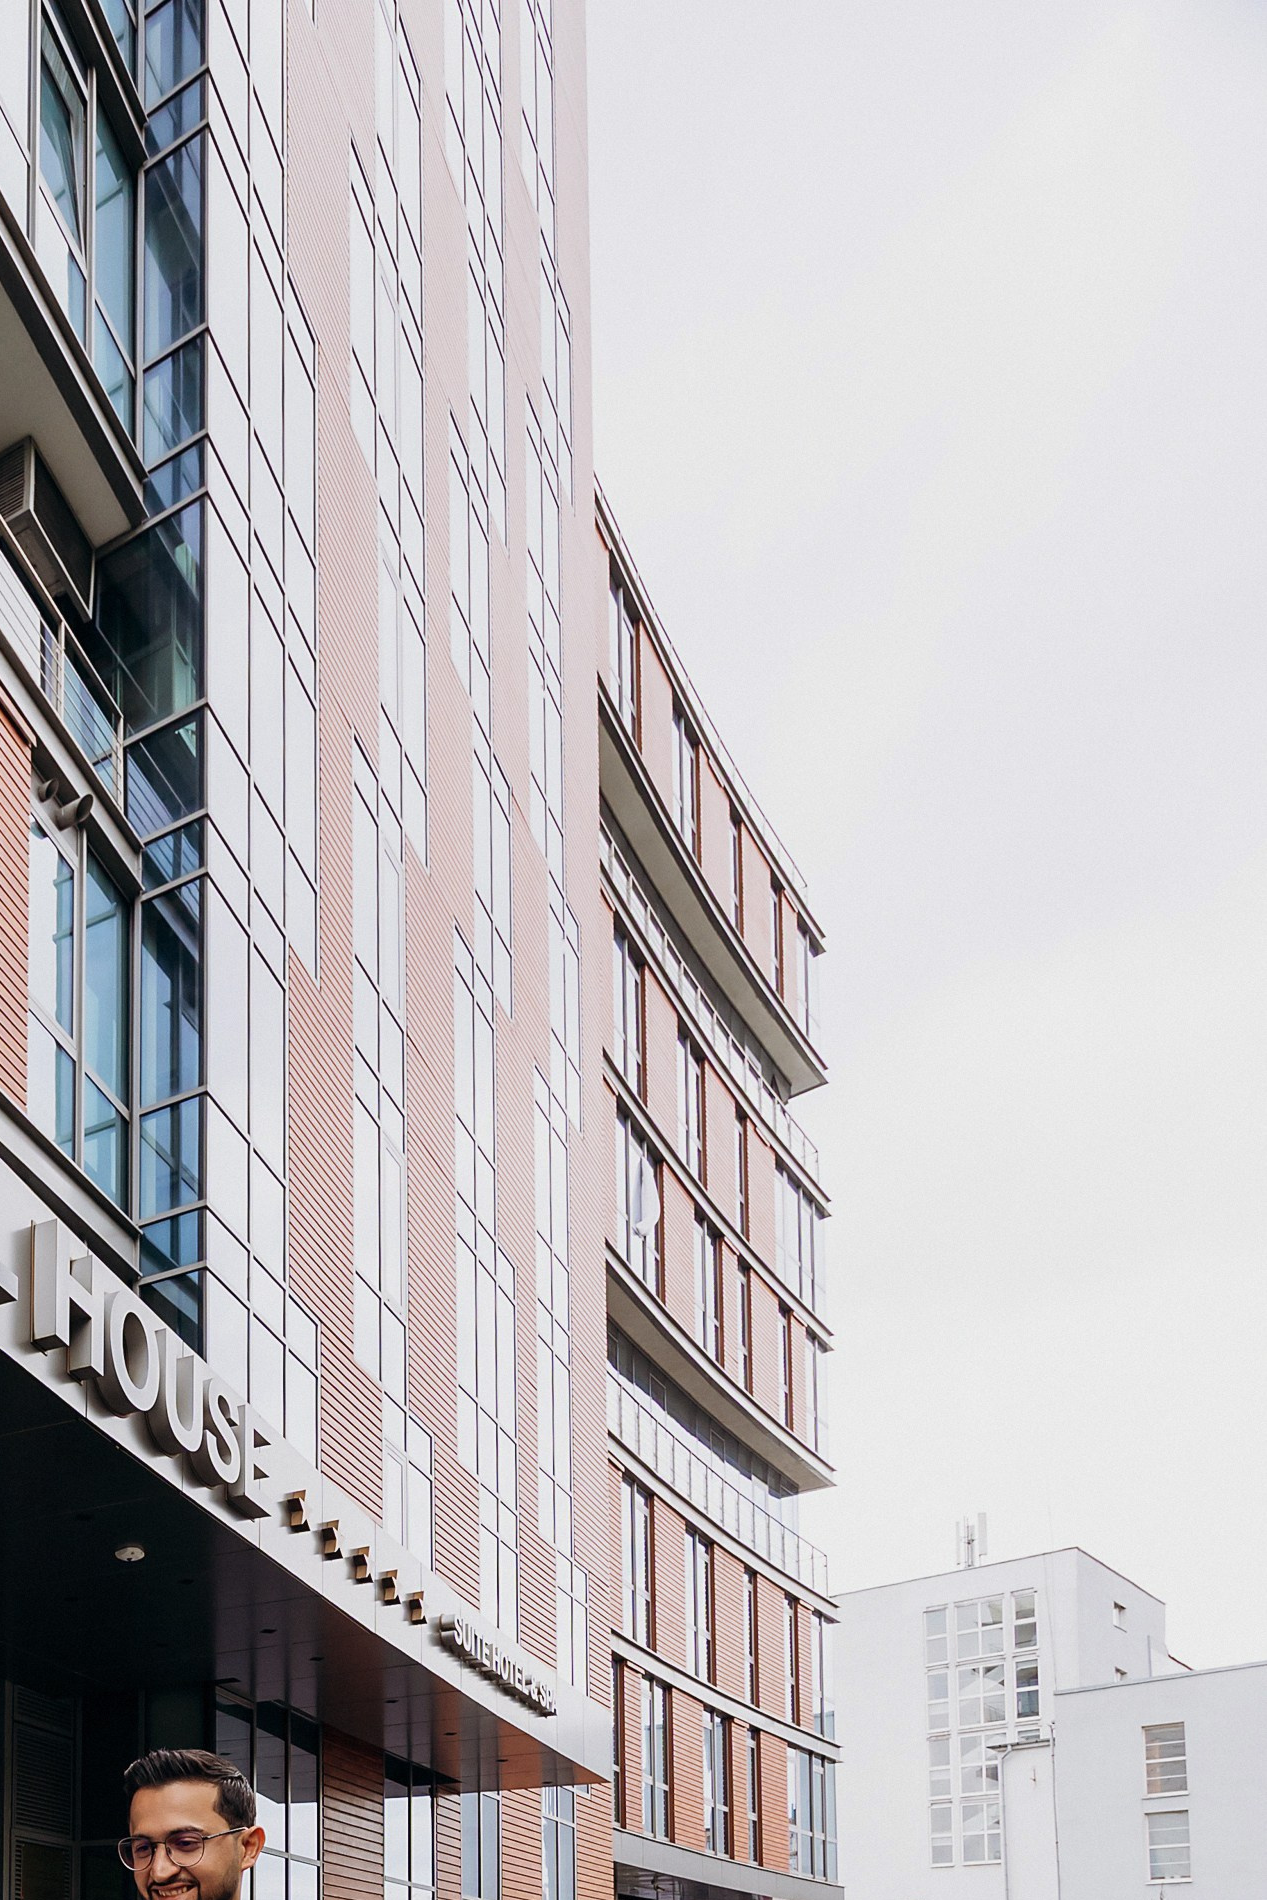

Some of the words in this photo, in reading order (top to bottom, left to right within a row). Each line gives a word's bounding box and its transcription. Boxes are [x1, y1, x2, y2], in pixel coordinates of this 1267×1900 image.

[31, 1218, 276, 1520] HOUSE
[444, 1614, 492, 1668] SUITE
[492, 1644, 531, 1696] HOTEL
[538, 1682, 557, 1714] SPA
